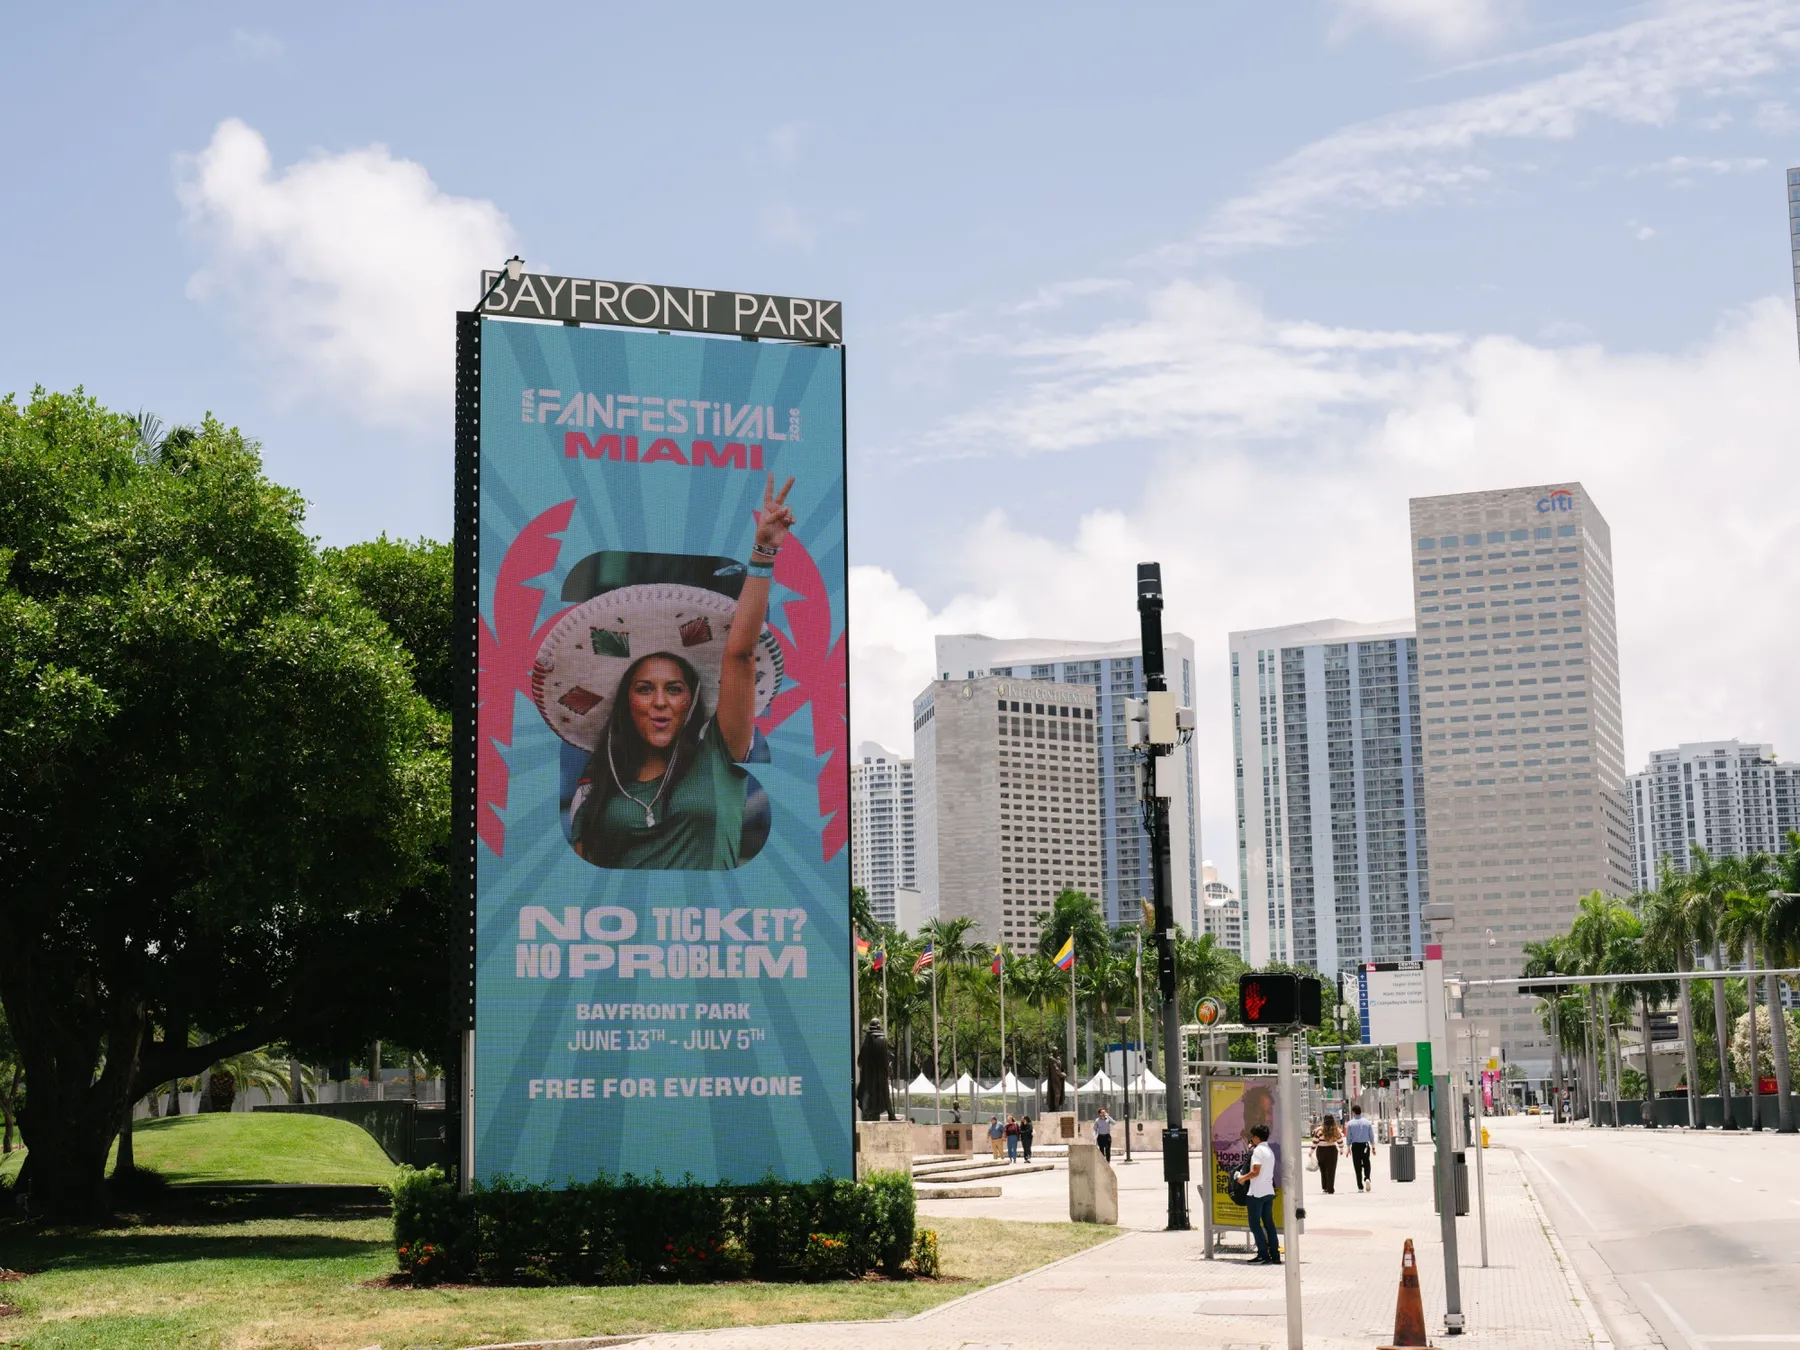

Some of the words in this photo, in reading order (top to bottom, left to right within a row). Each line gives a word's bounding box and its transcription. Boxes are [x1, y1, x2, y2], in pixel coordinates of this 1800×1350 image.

[485, 271, 715, 329] BAYFRONT
[735, 294, 840, 339] PARK
[522, 388, 534, 423] FIFA
[565, 431, 763, 470] MIAMI
[1536, 491, 1572, 513] citi
[519, 906, 638, 941] NO
[652, 907, 808, 941] TICKET?
[516, 943, 561, 979] NO
[569, 944, 808, 979] PROBLEM
[576, 1003, 690, 1020] BAYFRONT
[695, 1003, 751, 1019] PARK
[568, 1030, 621, 1051] JUNE
[626, 1028, 665, 1050] 13TH
[684, 1029, 732, 1050] JULY
[737, 1028, 765, 1050] 5TH
[529, 1079, 596, 1099] FREE
[603, 1078, 656, 1098] FOR
[664, 1076, 803, 1097] EVERYONE
[1217, 1151, 1240, 1163] Hope
